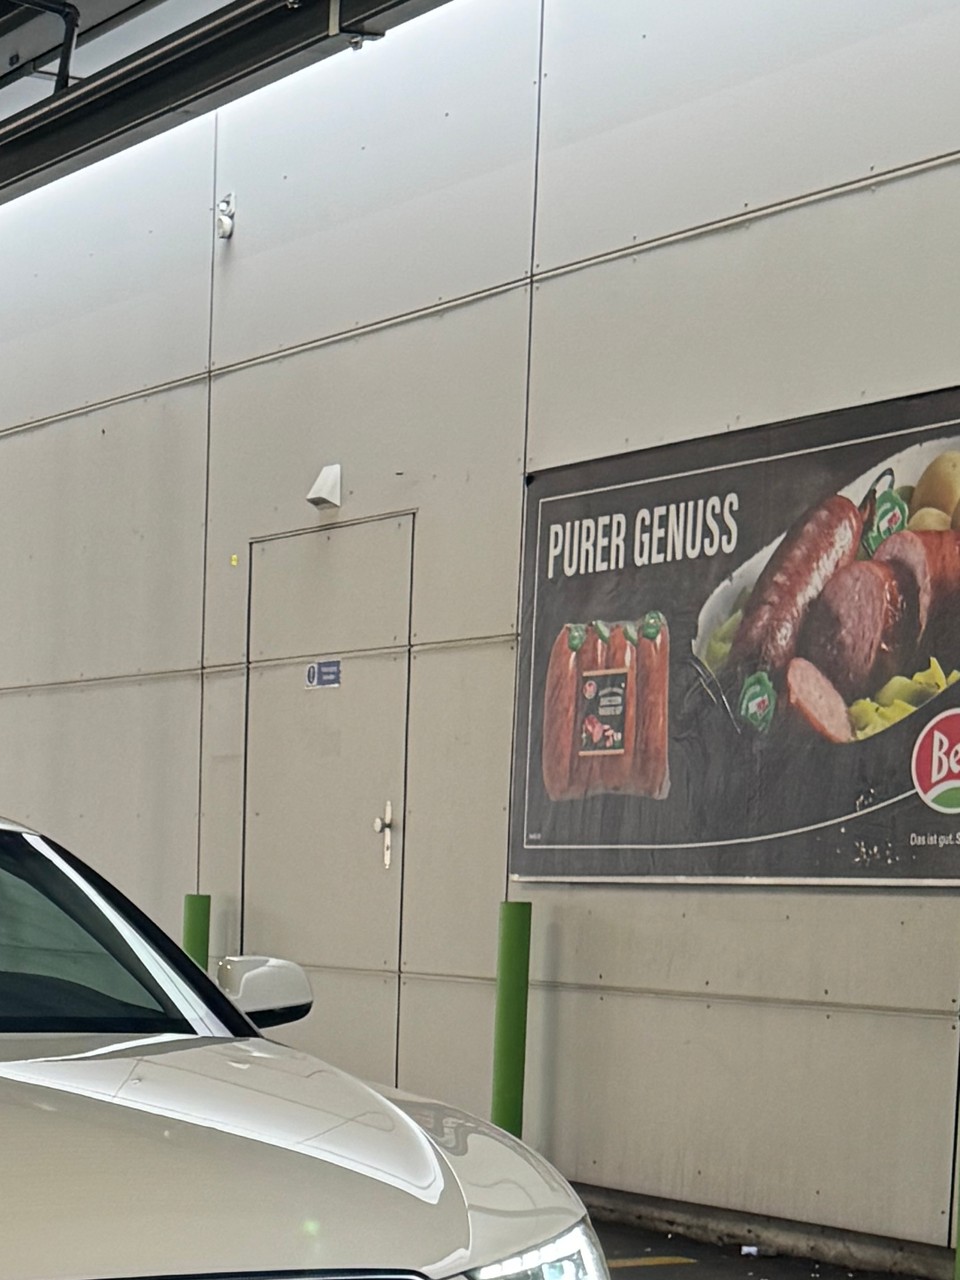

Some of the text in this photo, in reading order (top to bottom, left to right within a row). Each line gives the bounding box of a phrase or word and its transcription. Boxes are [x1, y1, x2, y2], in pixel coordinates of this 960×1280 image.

[547, 492, 739, 579] PURER GENUSS
[910, 832, 926, 846] Das
[927, 832, 937, 845] ist
